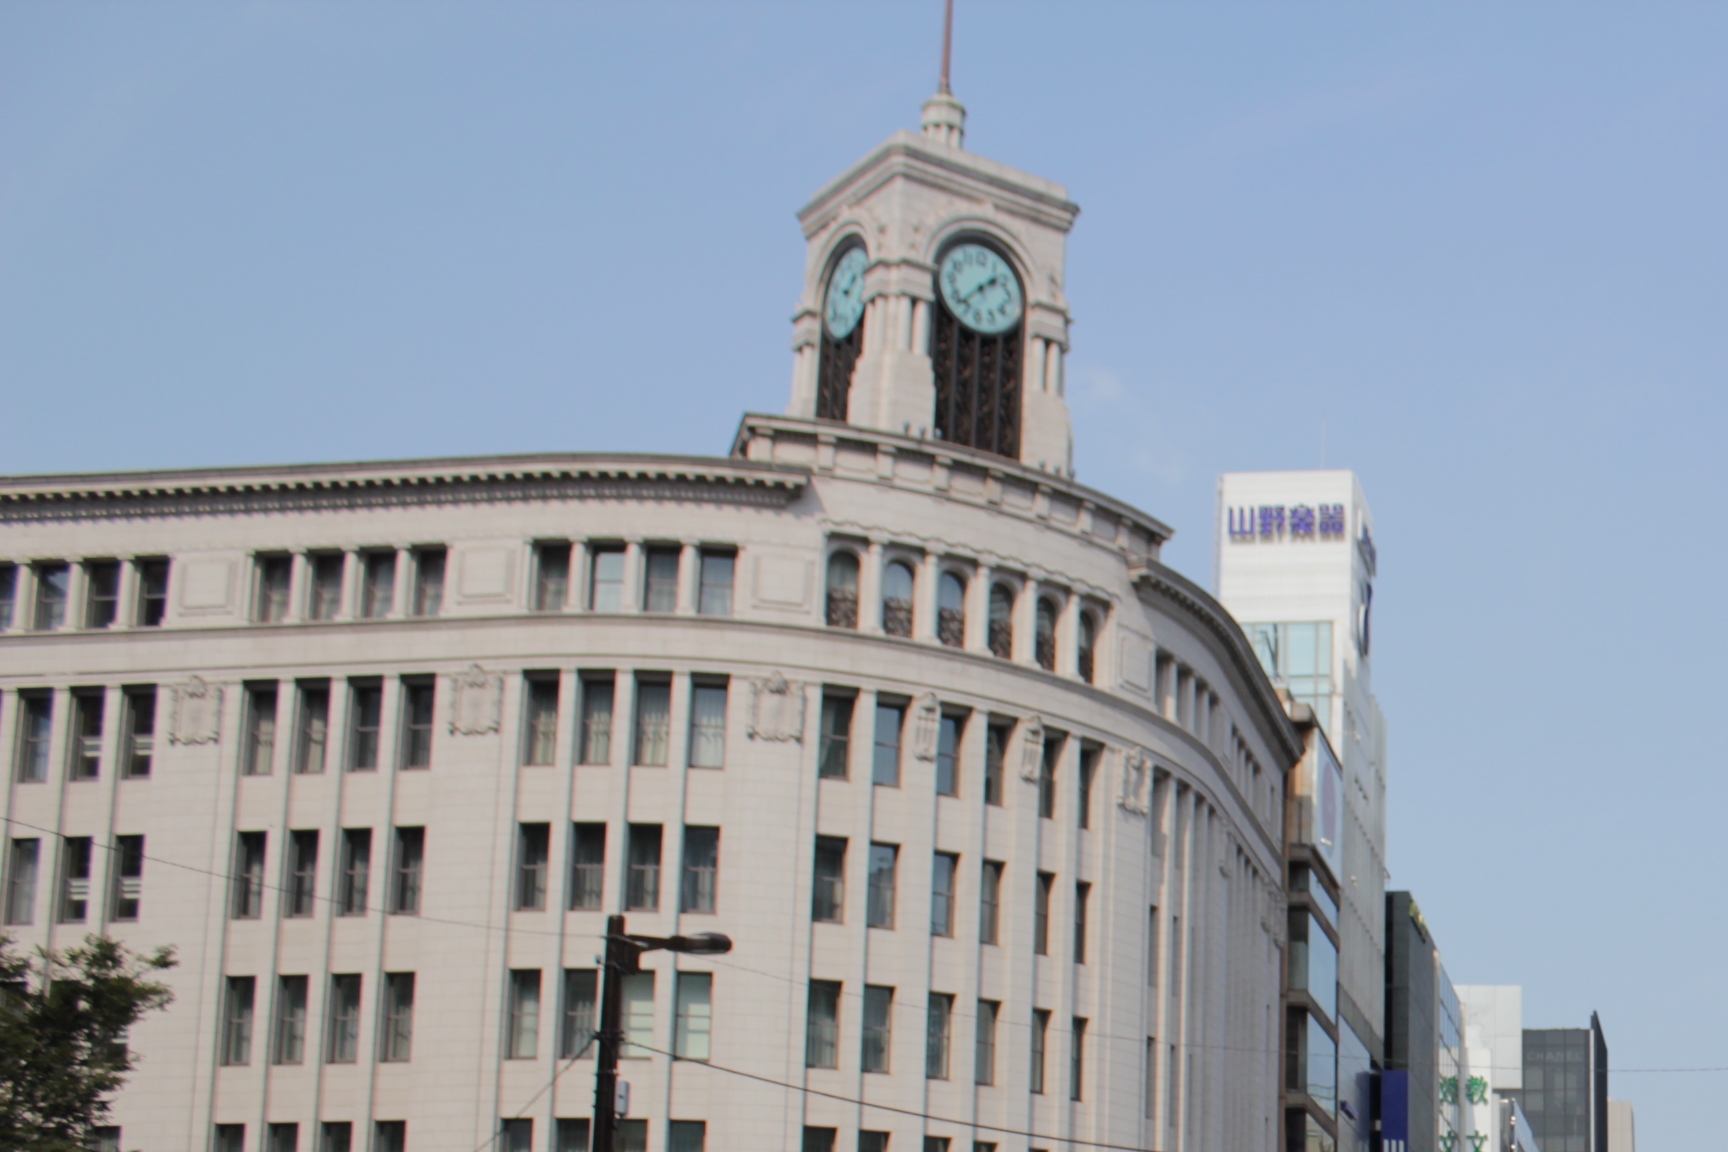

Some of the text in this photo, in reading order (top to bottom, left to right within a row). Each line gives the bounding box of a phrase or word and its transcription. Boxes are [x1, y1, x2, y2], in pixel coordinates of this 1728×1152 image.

[1228, 503, 1345, 535] 山野楽器
[1526, 1050, 1586, 1062] CHANEL
